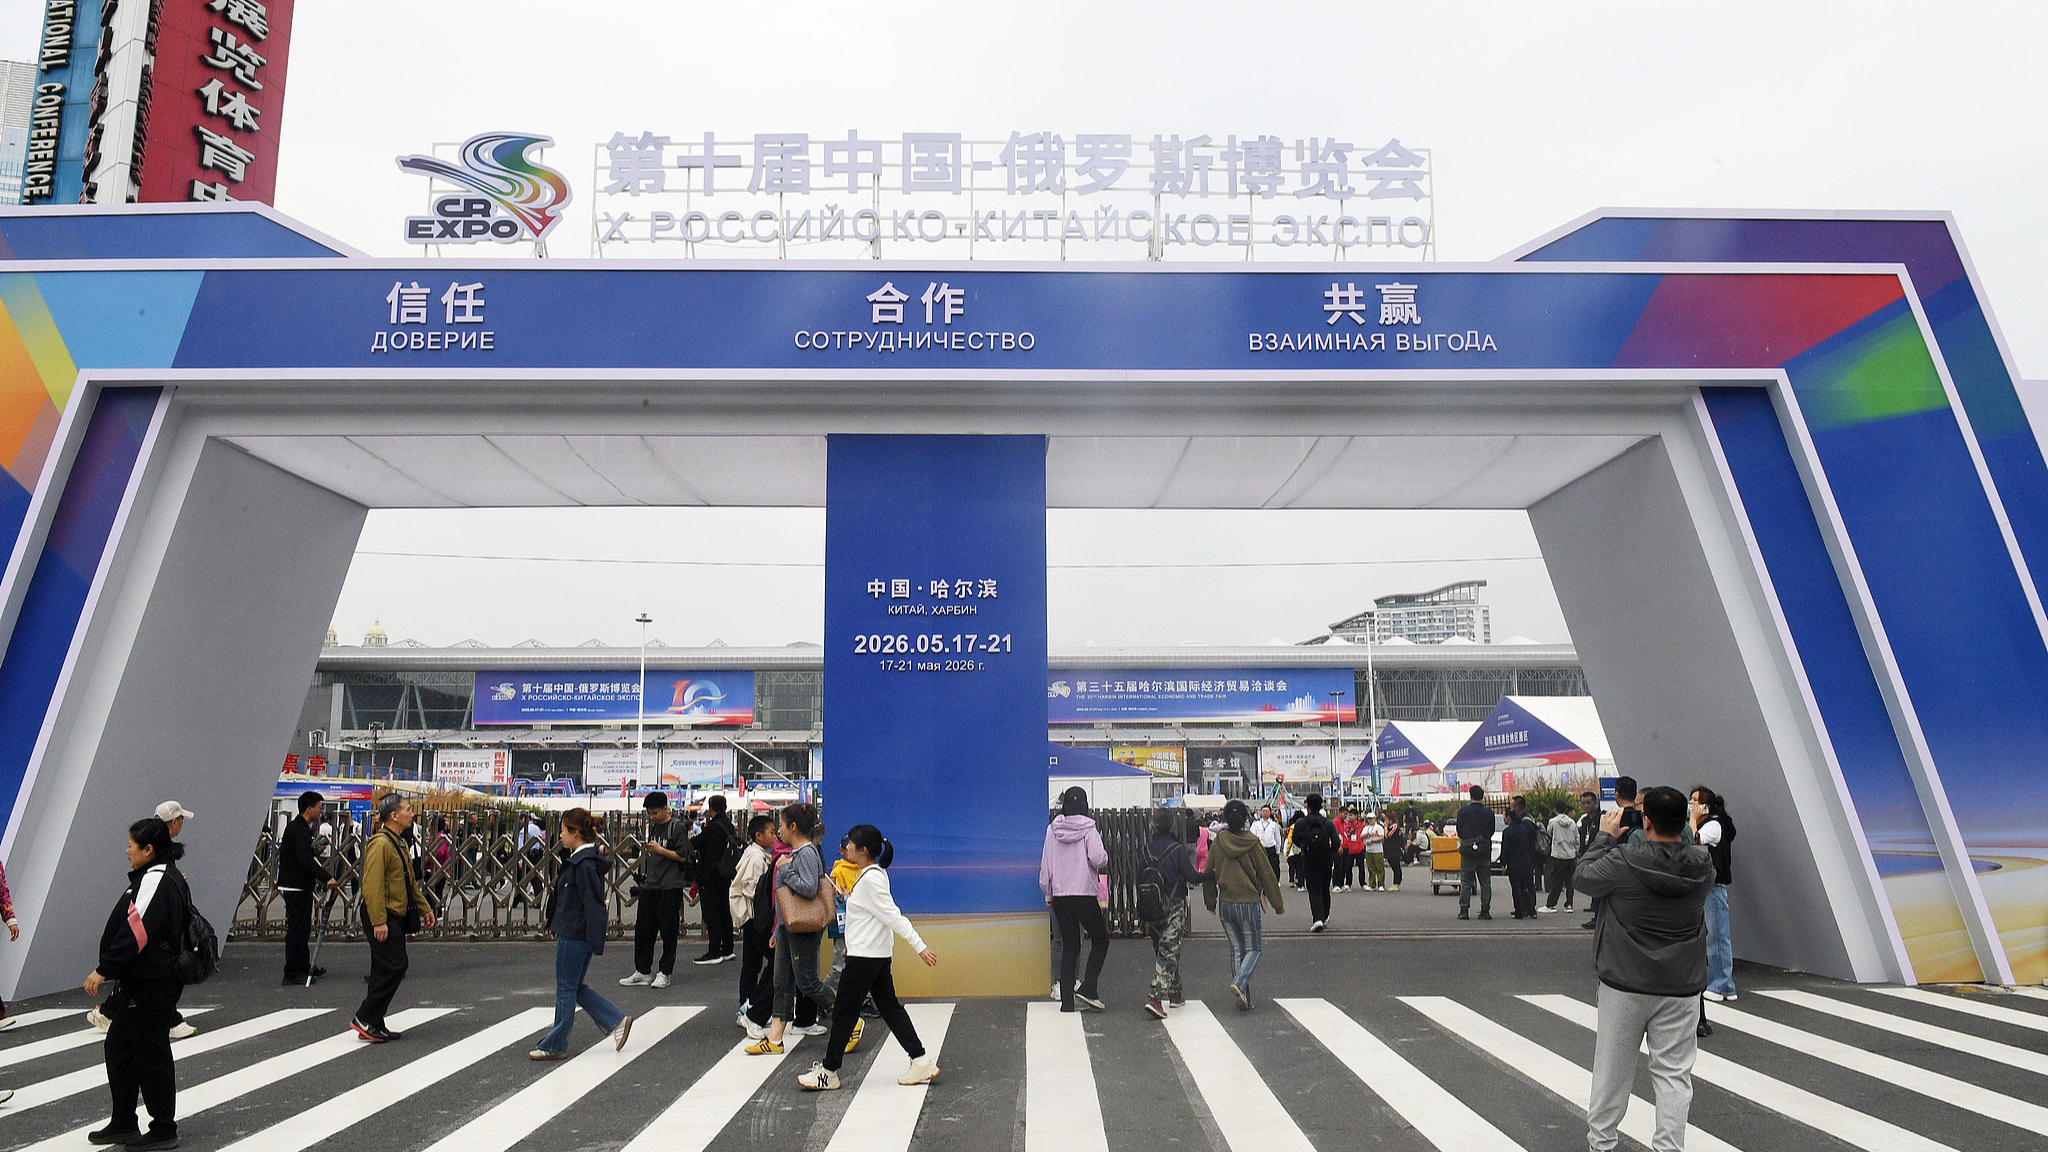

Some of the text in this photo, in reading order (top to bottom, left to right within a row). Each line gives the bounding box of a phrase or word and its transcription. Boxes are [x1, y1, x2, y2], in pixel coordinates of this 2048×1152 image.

[604, 129, 1427, 202] 第十届中国-俄罗斯博览会
[436, 198, 492, 218] CR
[408, 219, 519, 239] EXPO
[1271, 215, 1430, 249] ЭКСПО
[386, 281, 486, 325] 信任
[866, 281, 965, 324] 合作
[1323, 282, 1422, 326] 共赢
[371, 331, 495, 353] ДОВЕРИЕ
[794, 330, 1036, 353] СОТРУДНИЧЕСТВО
[1249, 330, 1498, 353] ВЗАИМНАЯ ВЫГОДА
[888, 603, 977, 616] КИТАЙ, ХАРБИН
[854, 634, 1012, 654] 2026.05.17-21
[879, 660, 985, 671] 17-21 мая 2026 г.
[1076, 680, 1287, 693] 第三十五届哈尔滨国际经济贸易洽谈会
[542, 761, 556, 773] 01
